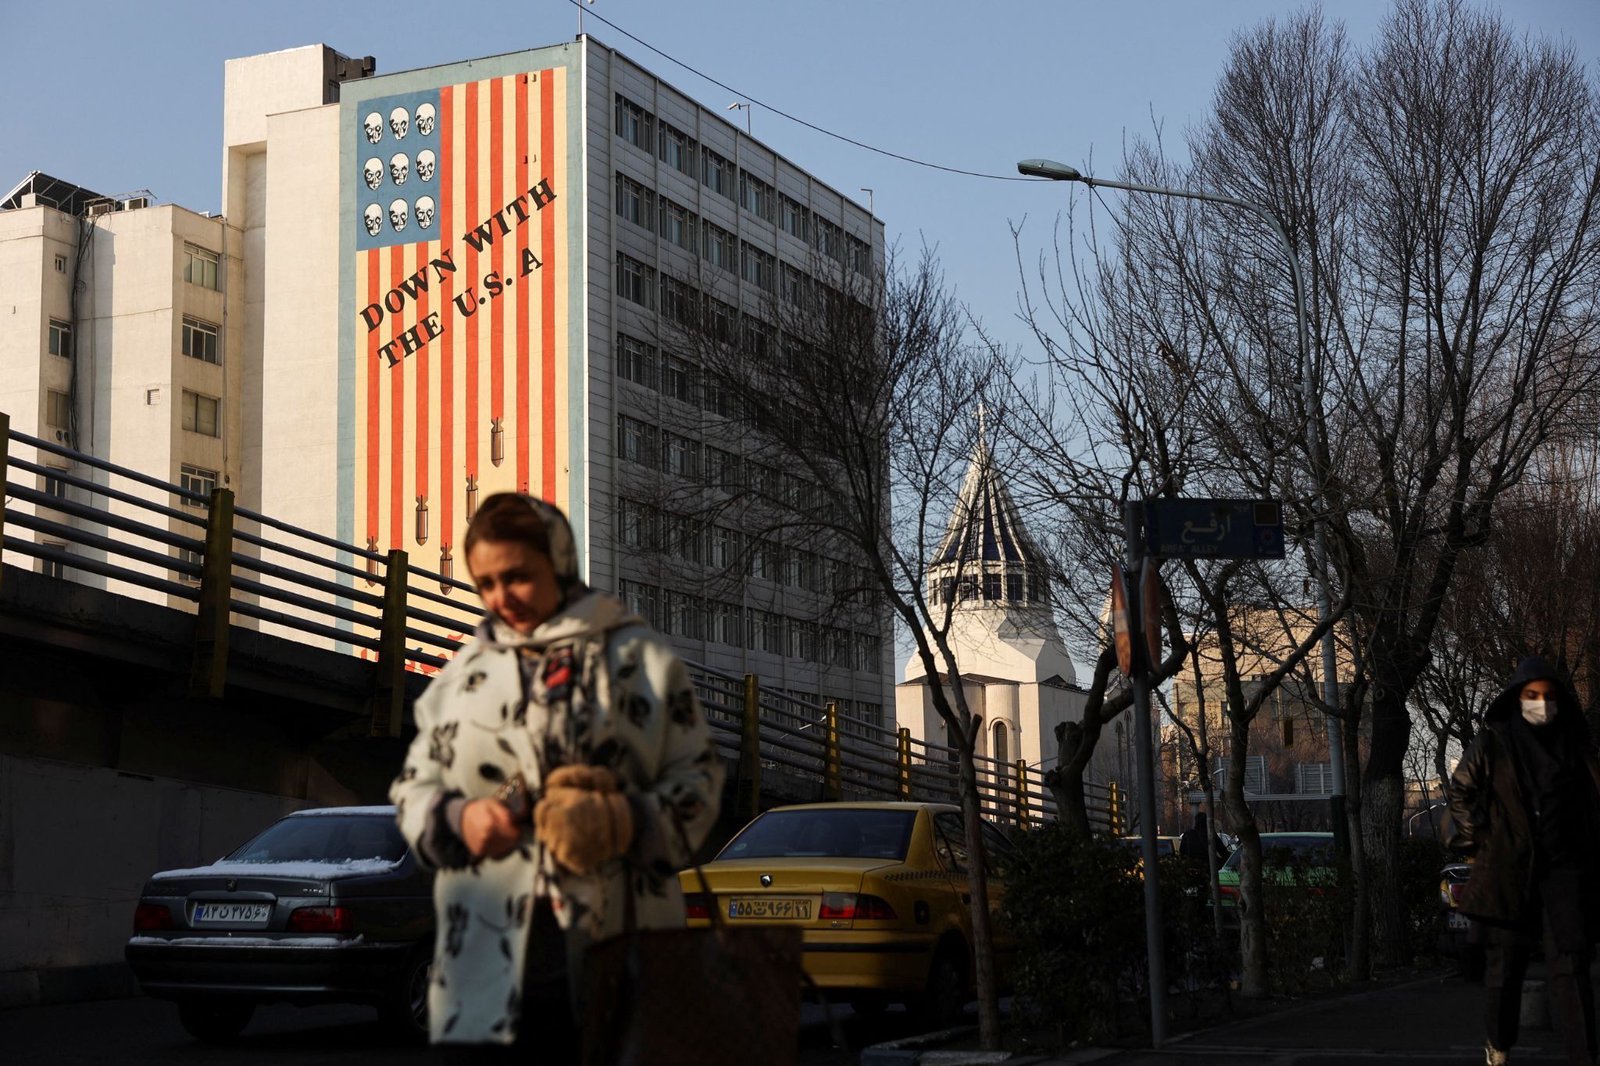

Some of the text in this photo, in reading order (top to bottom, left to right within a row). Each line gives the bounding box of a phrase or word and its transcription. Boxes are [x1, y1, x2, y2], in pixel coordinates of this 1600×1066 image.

[359, 177, 557, 333] DOWN WITH
[376, 311, 445, 369] THE
[1181, 512, 1231, 544] ارفع
